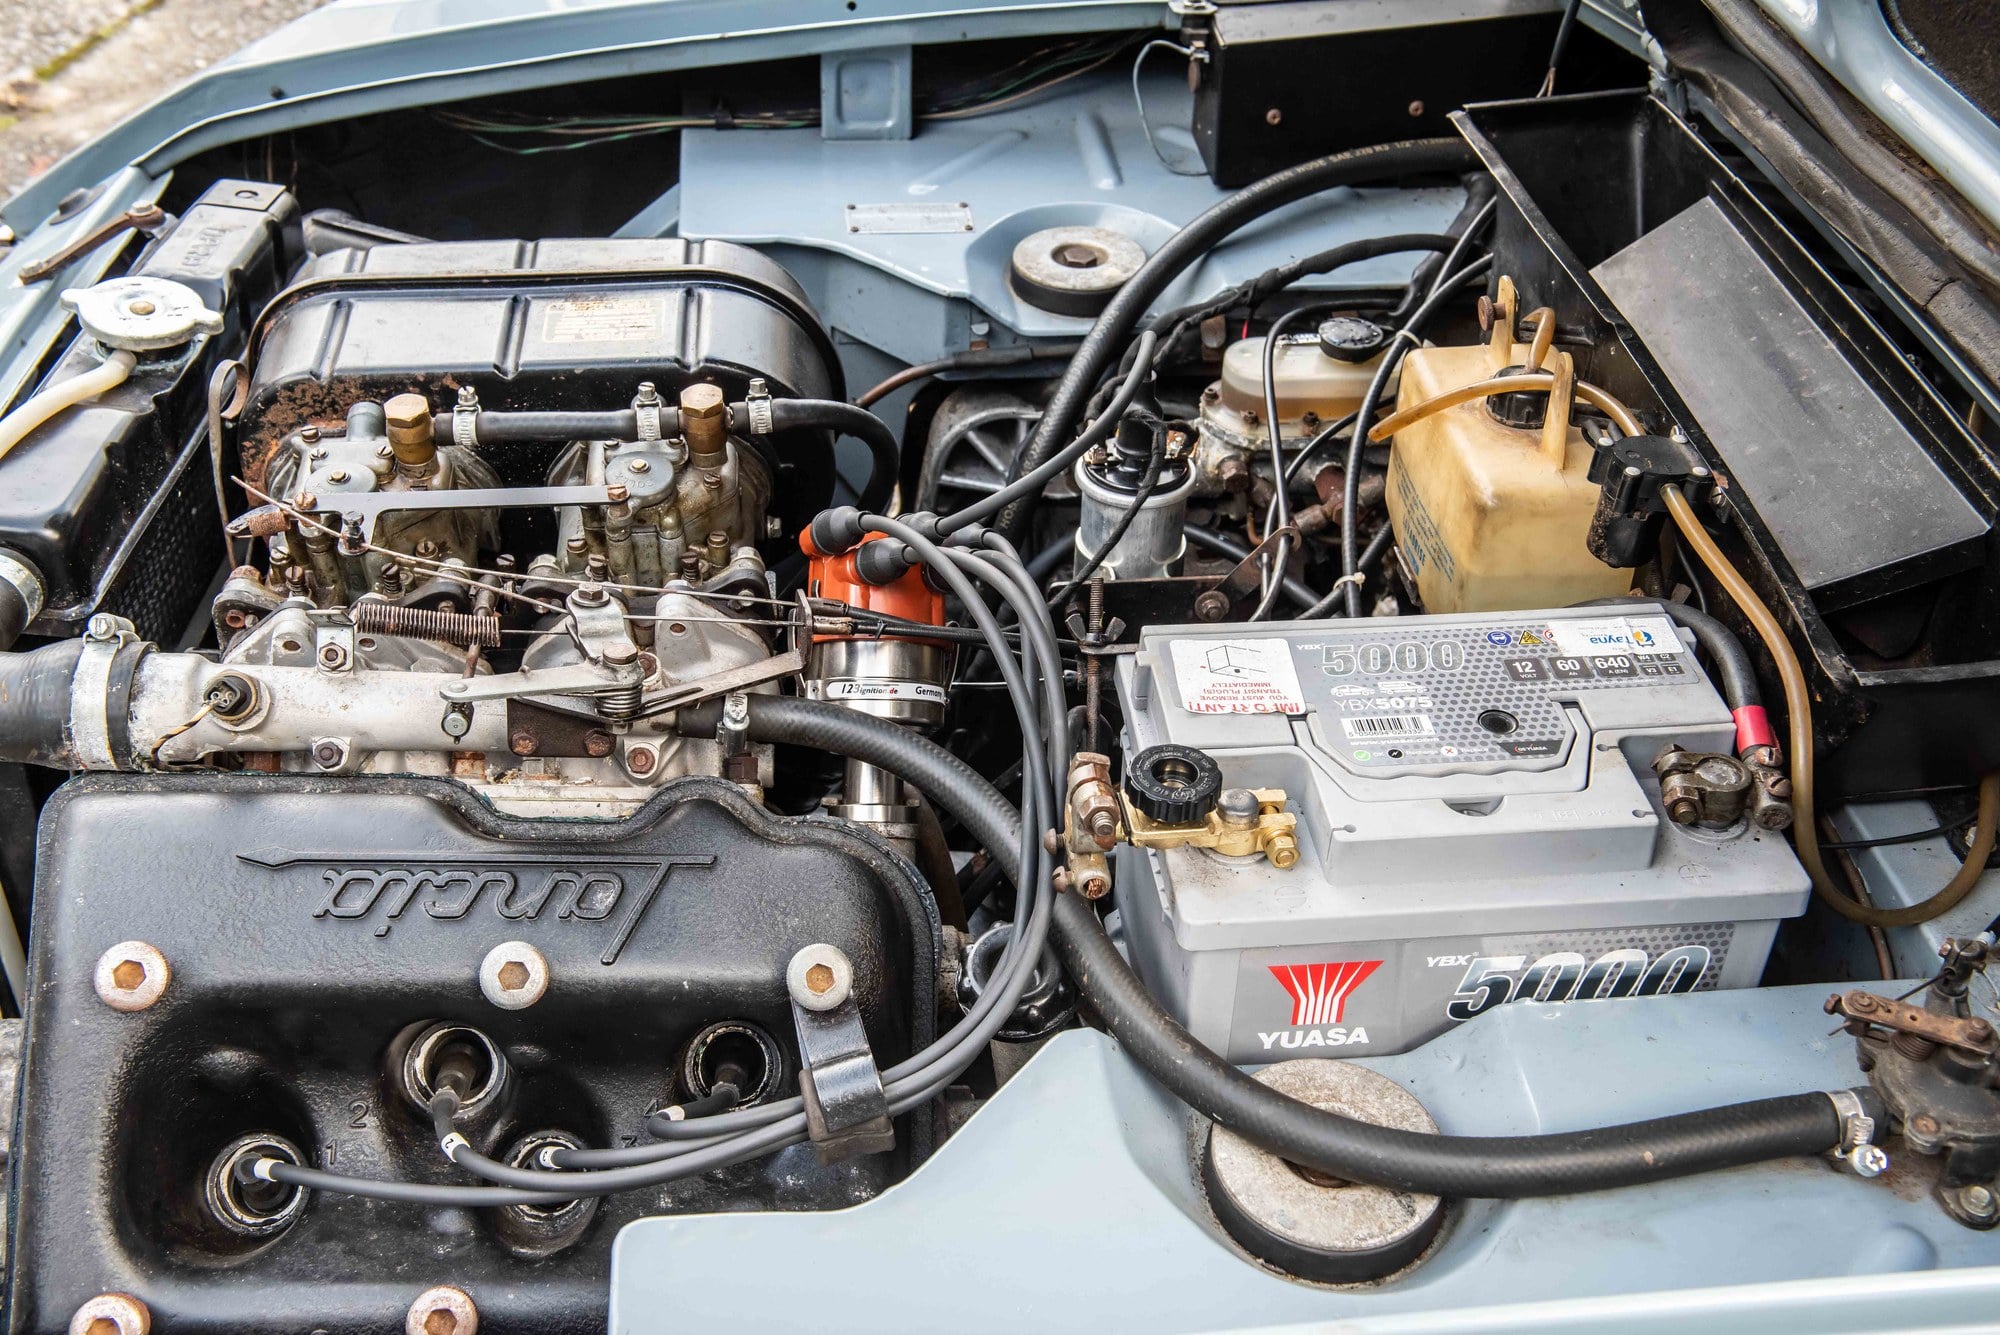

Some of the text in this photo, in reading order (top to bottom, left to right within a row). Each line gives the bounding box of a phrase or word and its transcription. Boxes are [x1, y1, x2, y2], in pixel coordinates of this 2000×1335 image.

[1589, 635, 1634, 645] Tayna
[1322, 639, 1465, 677] 5000
[1512, 656, 1630, 674] 12 60 640
[1334, 696, 1434, 712] YBX5075
[1426, 944, 1711, 1023] YBX 5000
[1257, 1027, 1370, 1050] YUASA
[349, 1099, 369, 1128] 2
[325, 1138, 337, 1165] 1
